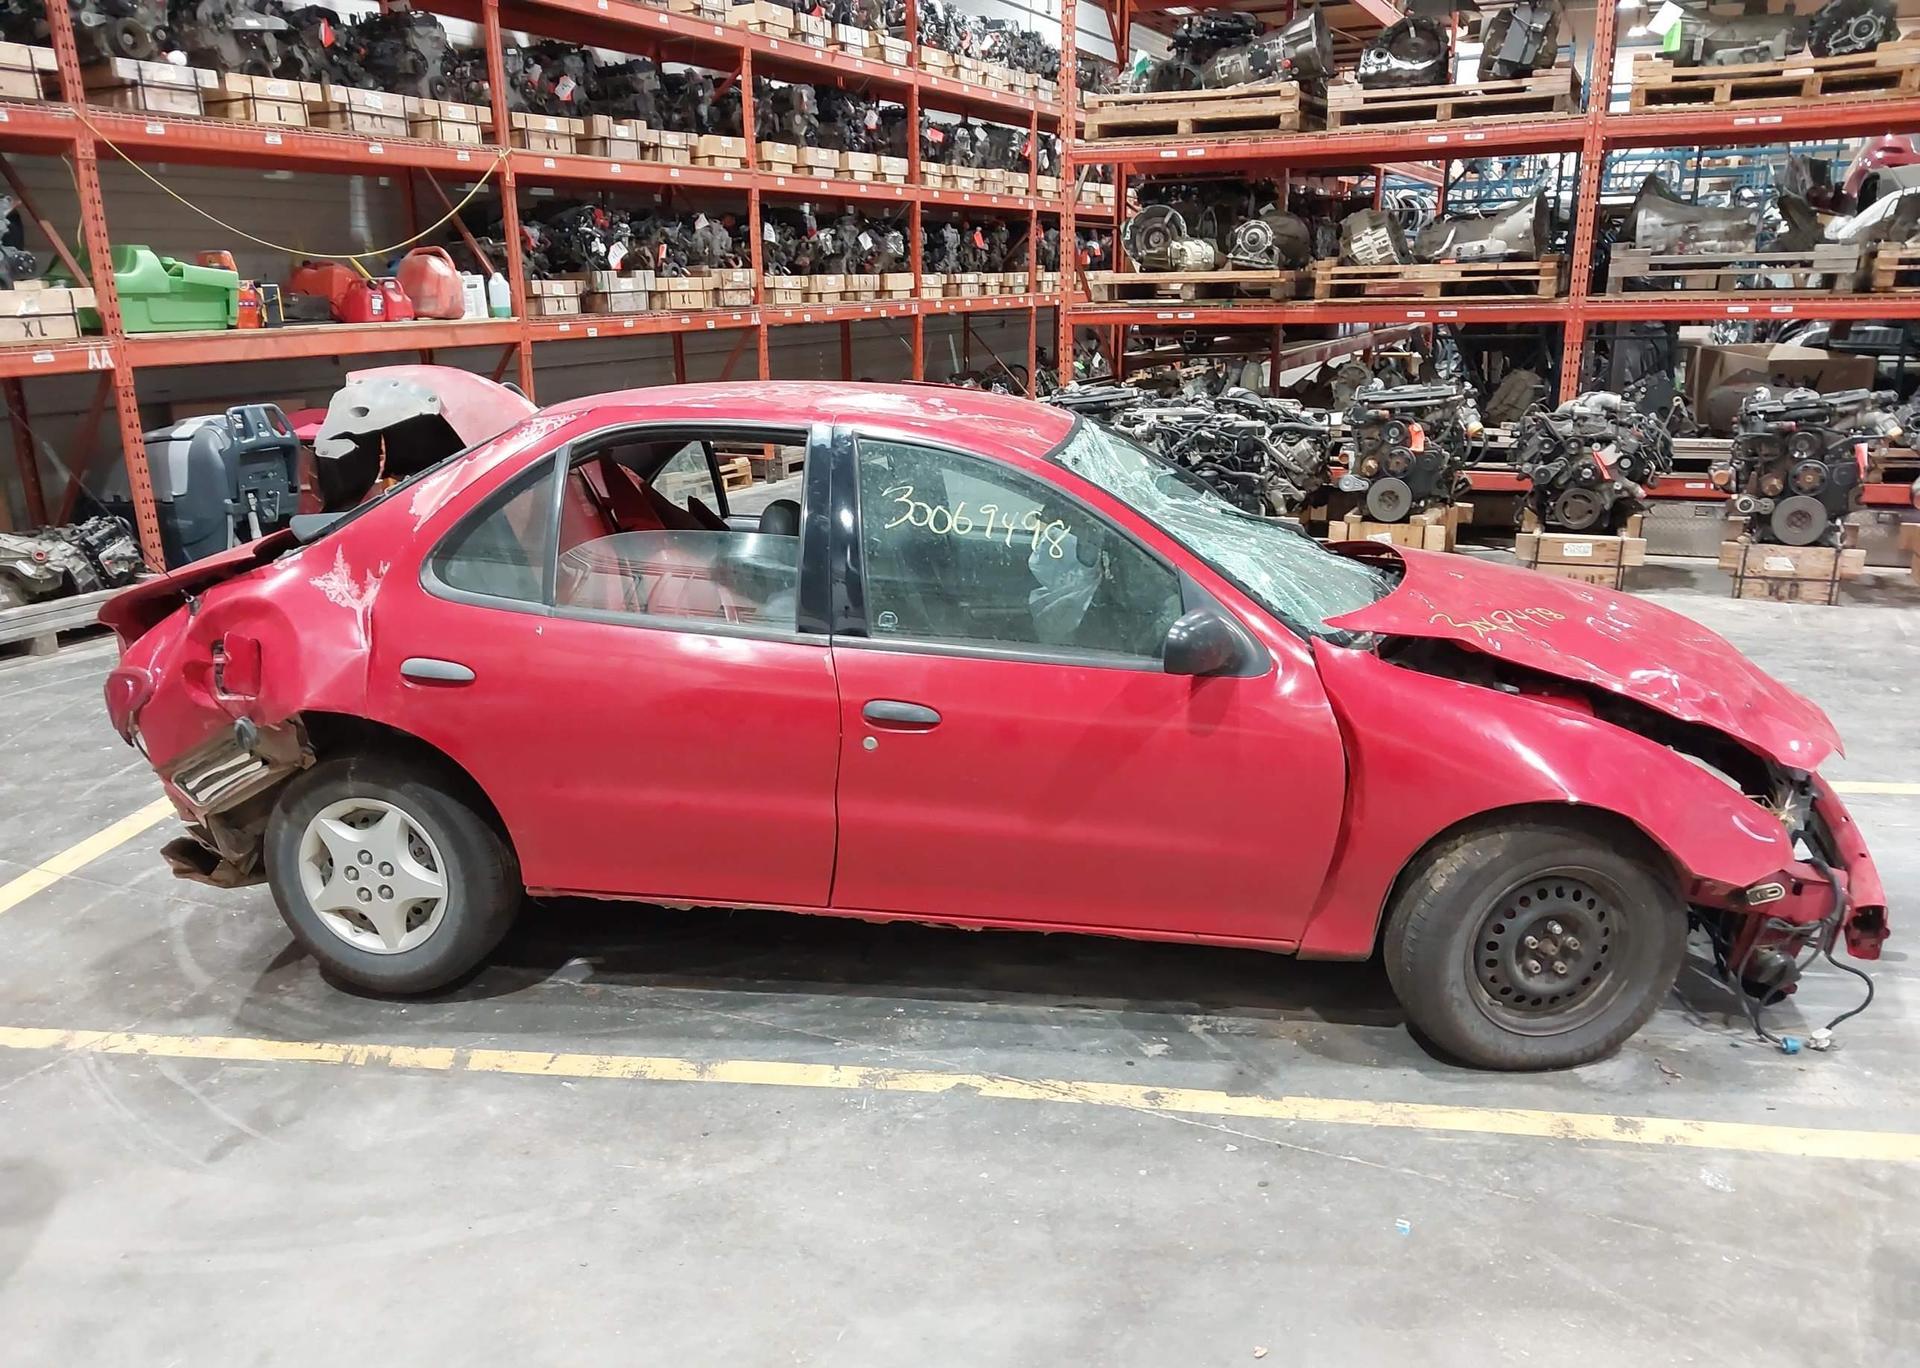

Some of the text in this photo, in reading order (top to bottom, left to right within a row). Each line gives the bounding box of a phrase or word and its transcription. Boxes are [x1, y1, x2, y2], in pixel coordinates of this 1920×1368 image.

[545, 137, 559, 151] XL
[556, 299, 567, 311] XL
[682, 293, 692, 305] XL
[22, 320, 47, 337] XL
[88, 347, 115, 370] AA
[881, 485, 1072, 559] 30069498
